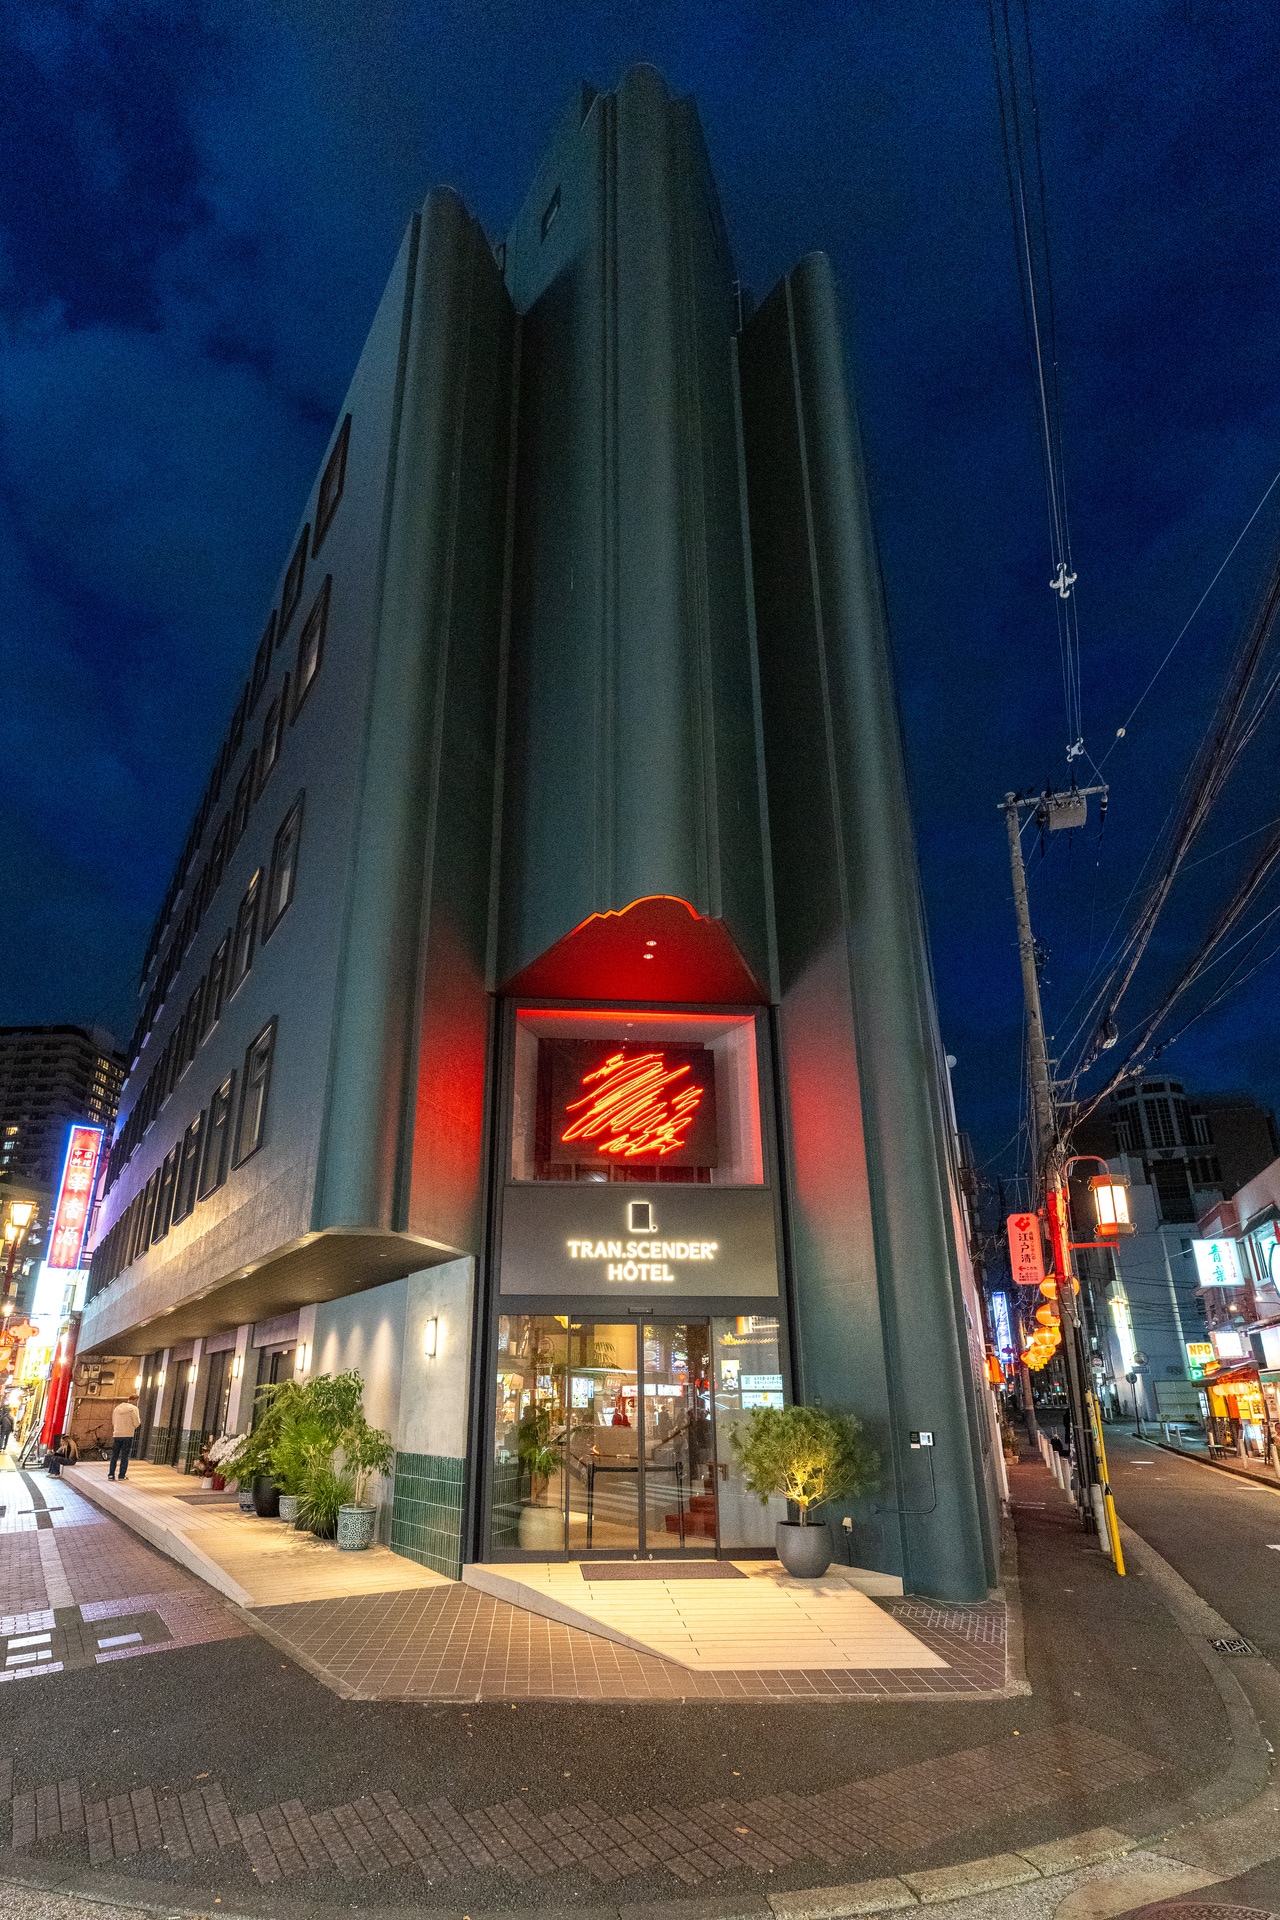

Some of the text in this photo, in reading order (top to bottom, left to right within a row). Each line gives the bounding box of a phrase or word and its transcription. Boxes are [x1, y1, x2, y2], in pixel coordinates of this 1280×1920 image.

[55, 1172, 90, 1246] 華香源
[1208, 1243, 1227, 1282] 青葉
[1188, 1344, 1212, 1356] NPC
